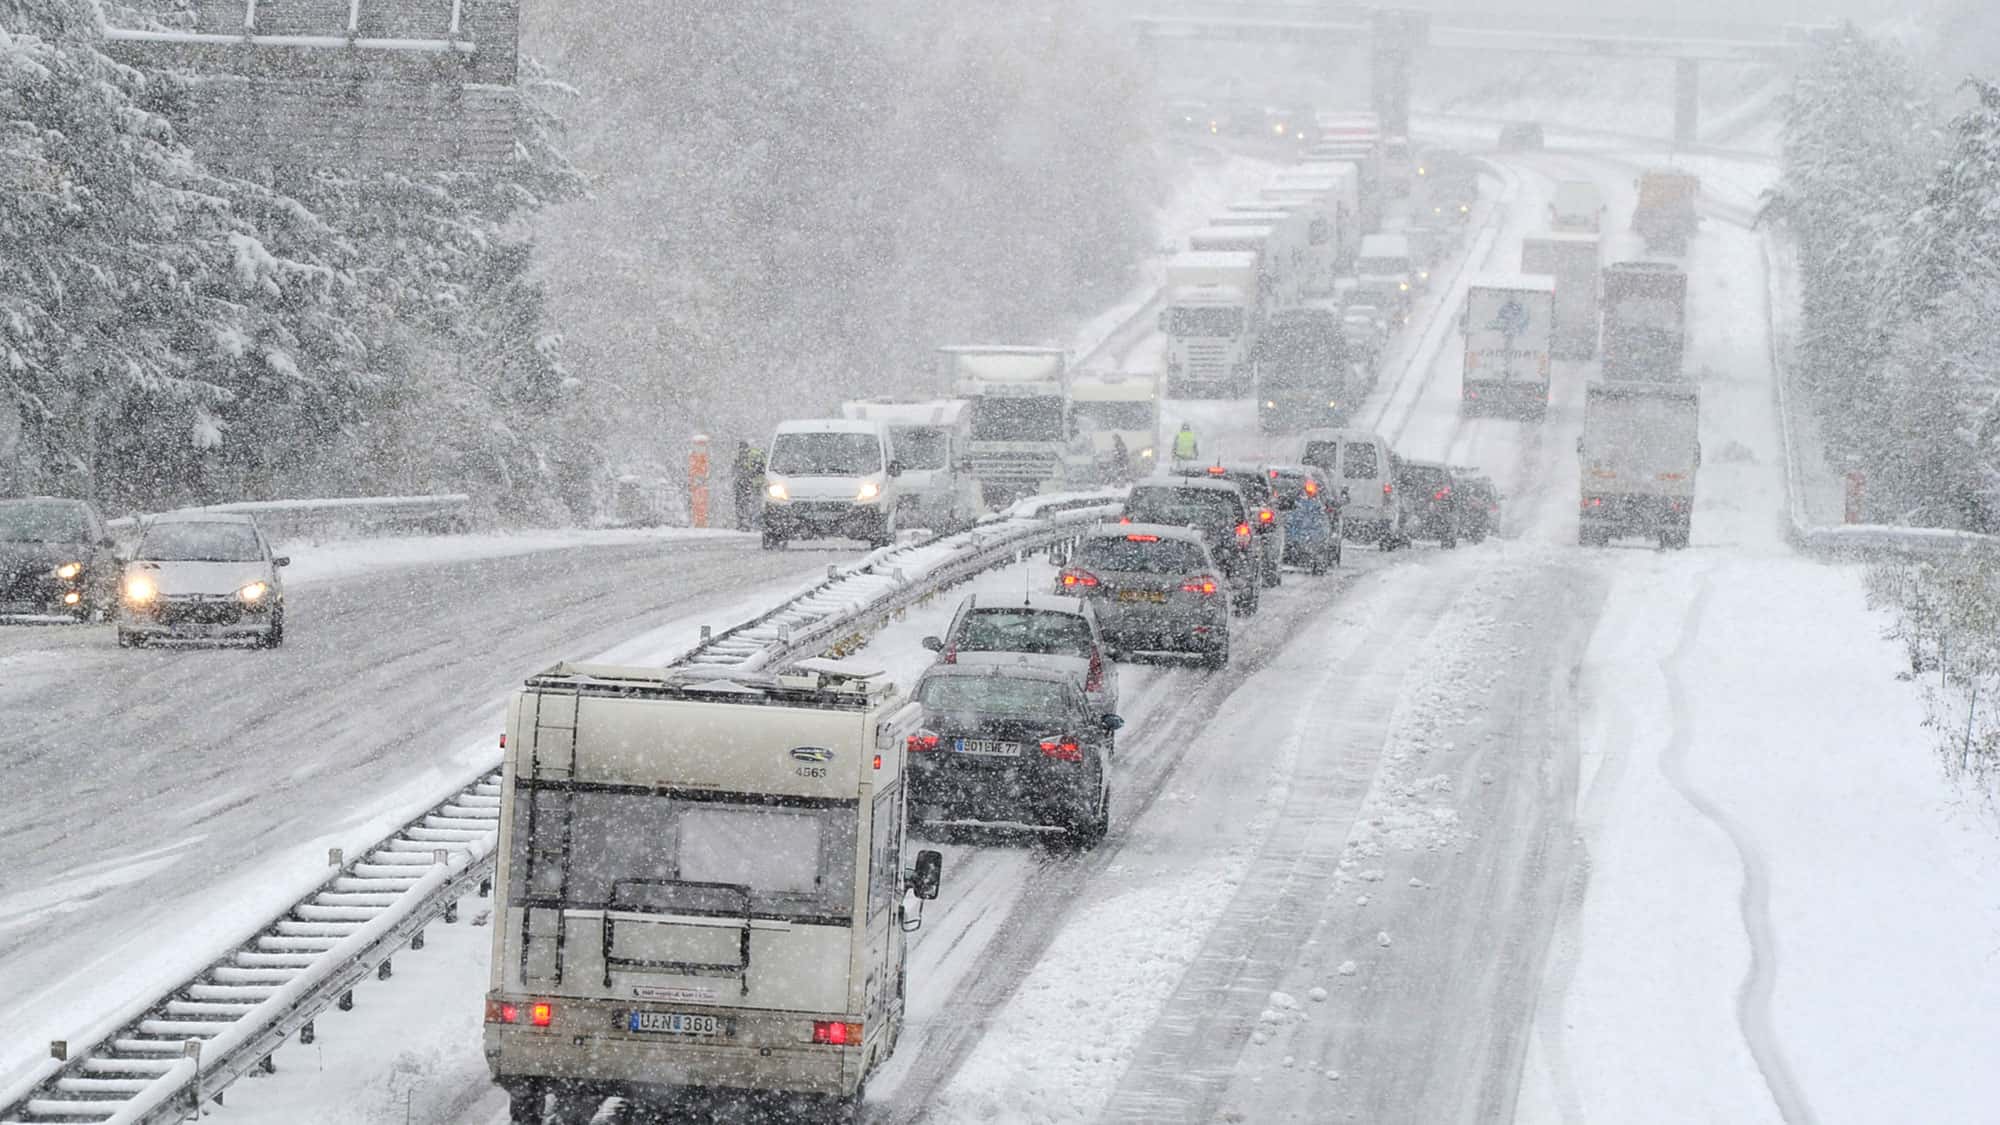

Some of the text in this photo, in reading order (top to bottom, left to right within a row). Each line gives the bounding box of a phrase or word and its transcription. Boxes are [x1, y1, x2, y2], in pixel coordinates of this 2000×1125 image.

[795, 767, 827, 779] 4563
[641, 1014, 713, 1033] UAN 368
